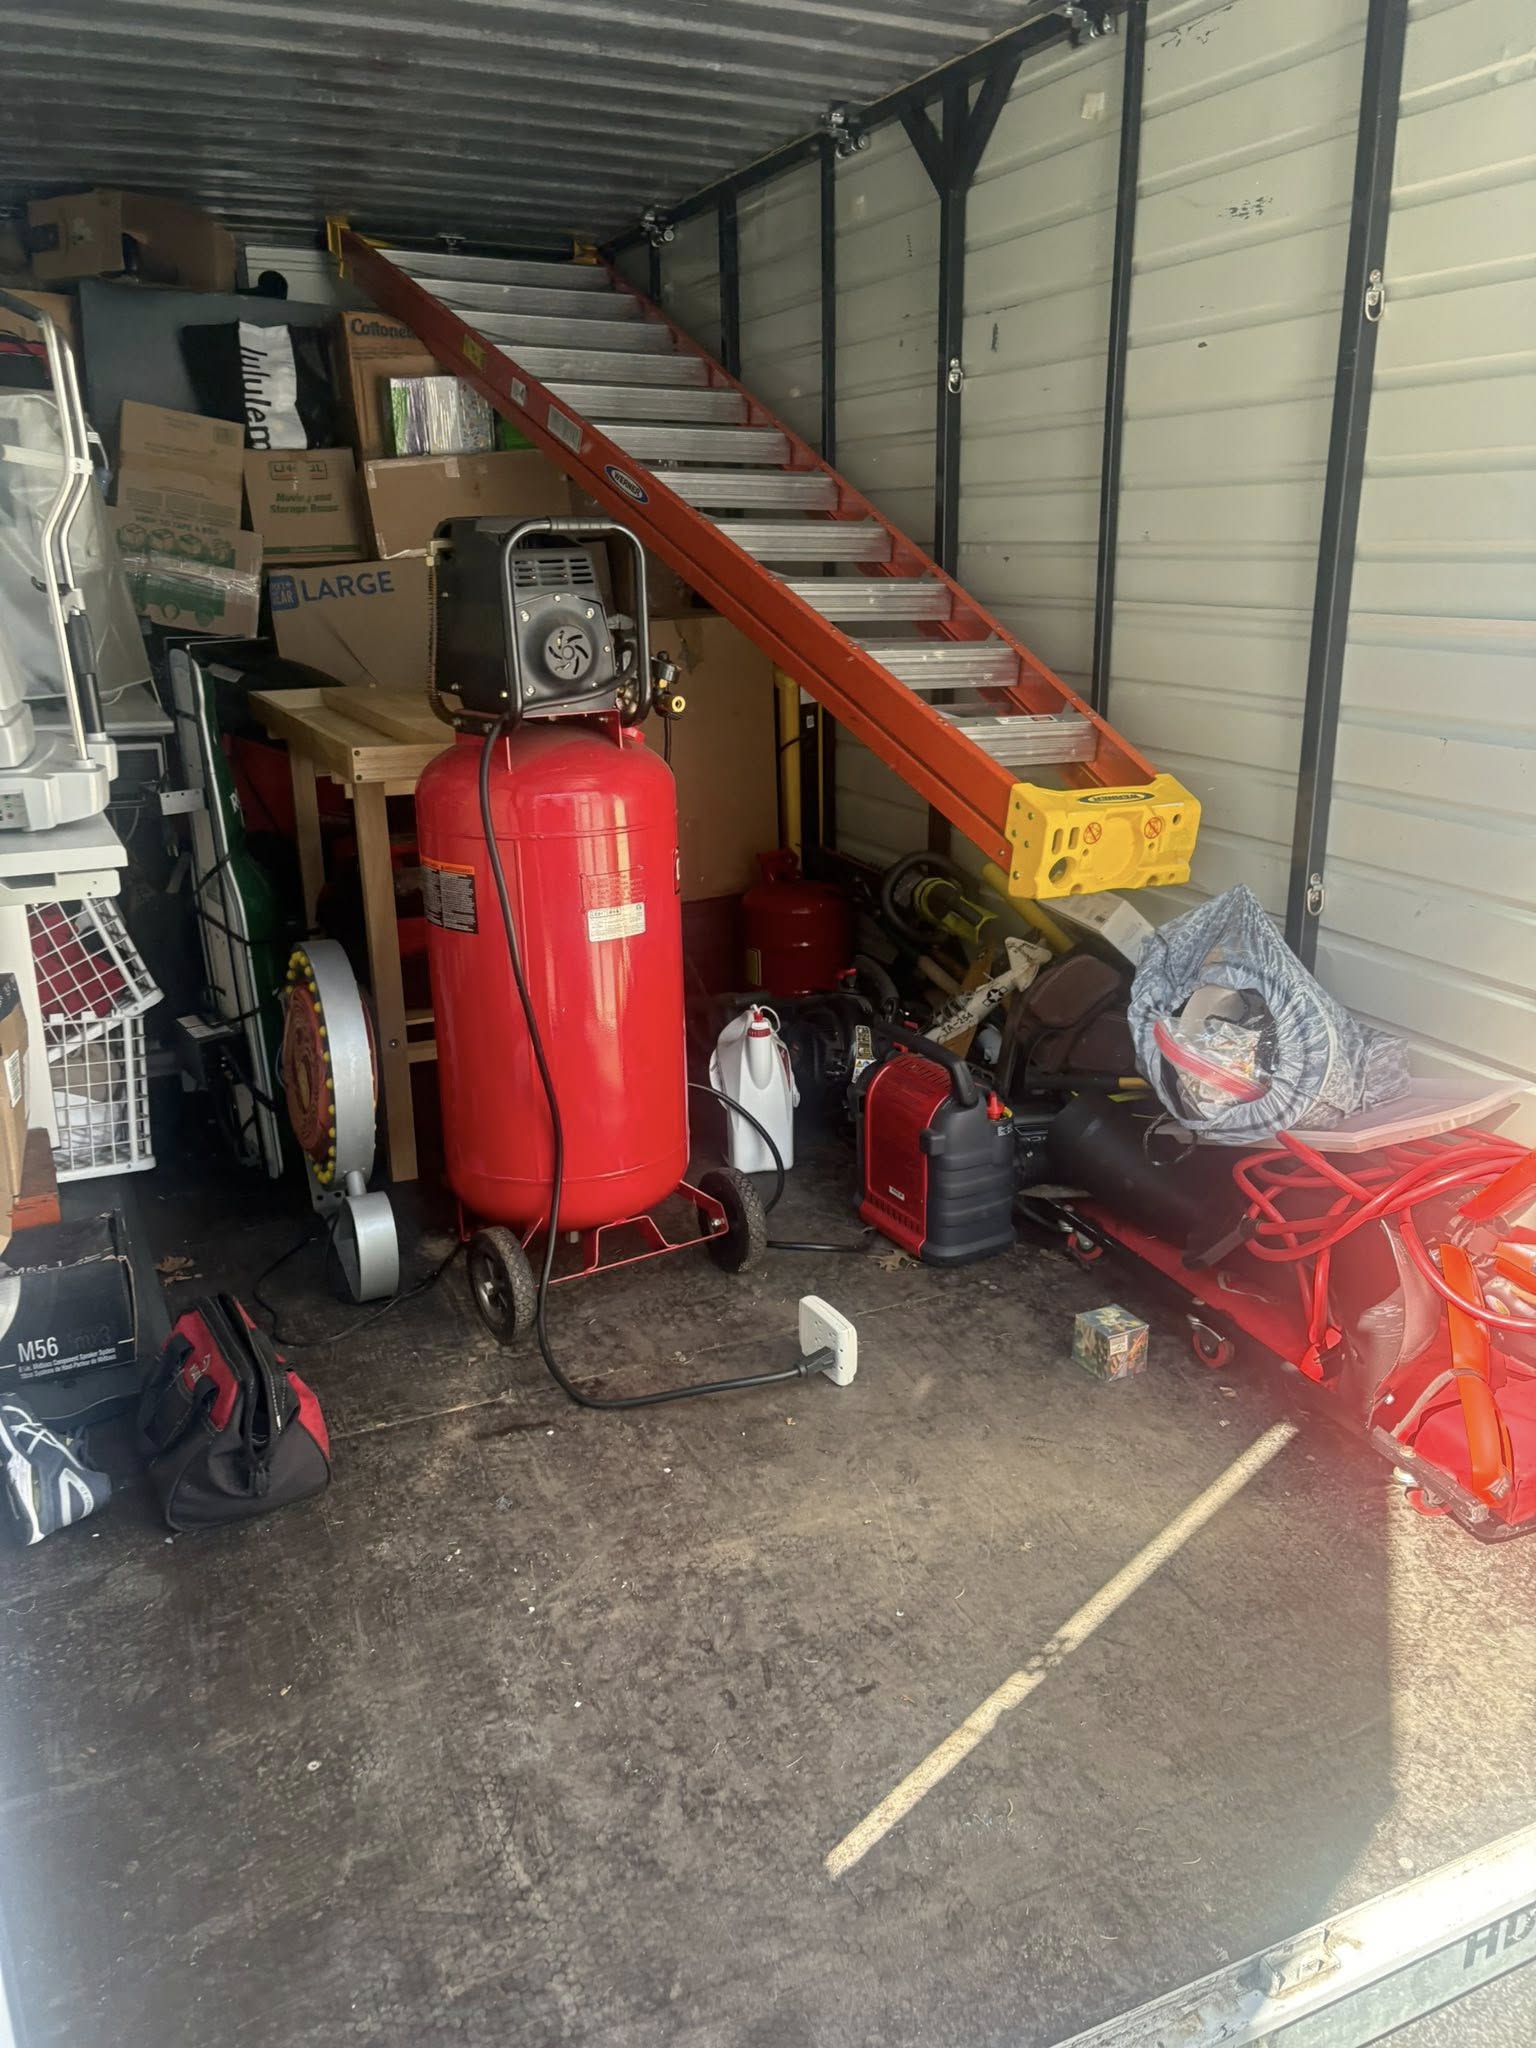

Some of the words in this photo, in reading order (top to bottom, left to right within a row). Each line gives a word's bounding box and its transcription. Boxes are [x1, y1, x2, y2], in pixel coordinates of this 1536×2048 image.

[614, 470, 641, 497] WERNER
[301, 571, 394, 602] LARGE
[17, 1336, 60, 1363] M56
